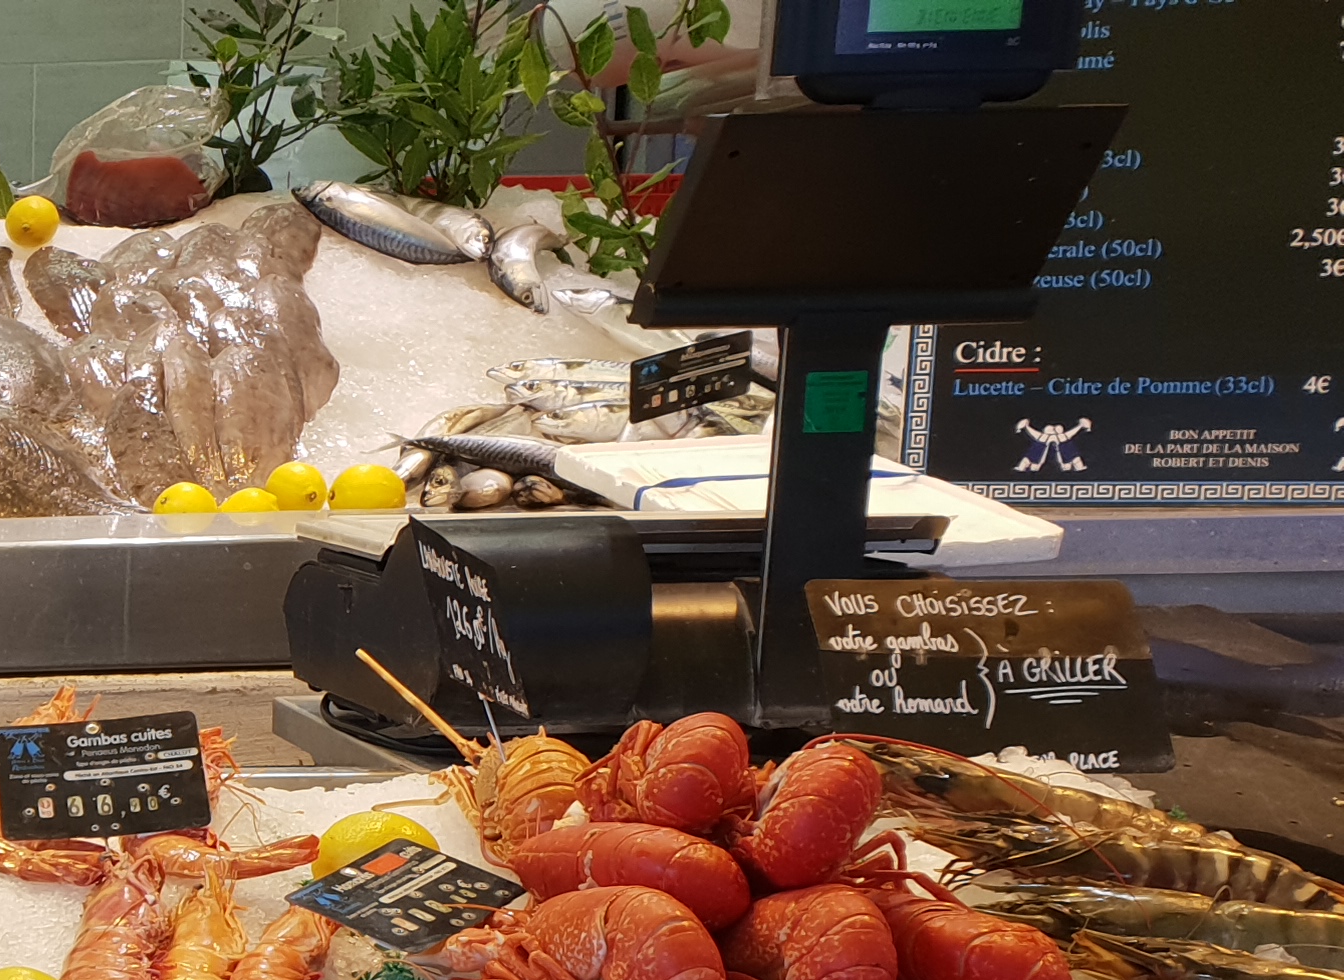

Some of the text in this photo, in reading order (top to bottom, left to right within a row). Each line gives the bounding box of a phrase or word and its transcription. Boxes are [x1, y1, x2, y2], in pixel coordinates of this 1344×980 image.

[954, 341, 1027, 364] Cidre
[953, 376, 1331, 397] Lucette Cidre de Pomme (33cl) 4€
[1170, 429, 1256, 440] BON APPETIT
[1125, 443, 1300, 454] DE LA PART DE LA MAISON
[1153, 457, 1269, 468] ROBERT ET DENIS
[824, 591, 879, 617] VOUS
[828, 622, 959, 657] votre gambas
[835, 680, 978, 715] votre homard
[67, 728, 172, 748] Gambas cuites
[1070, 751, 1120, 769] PLACE
